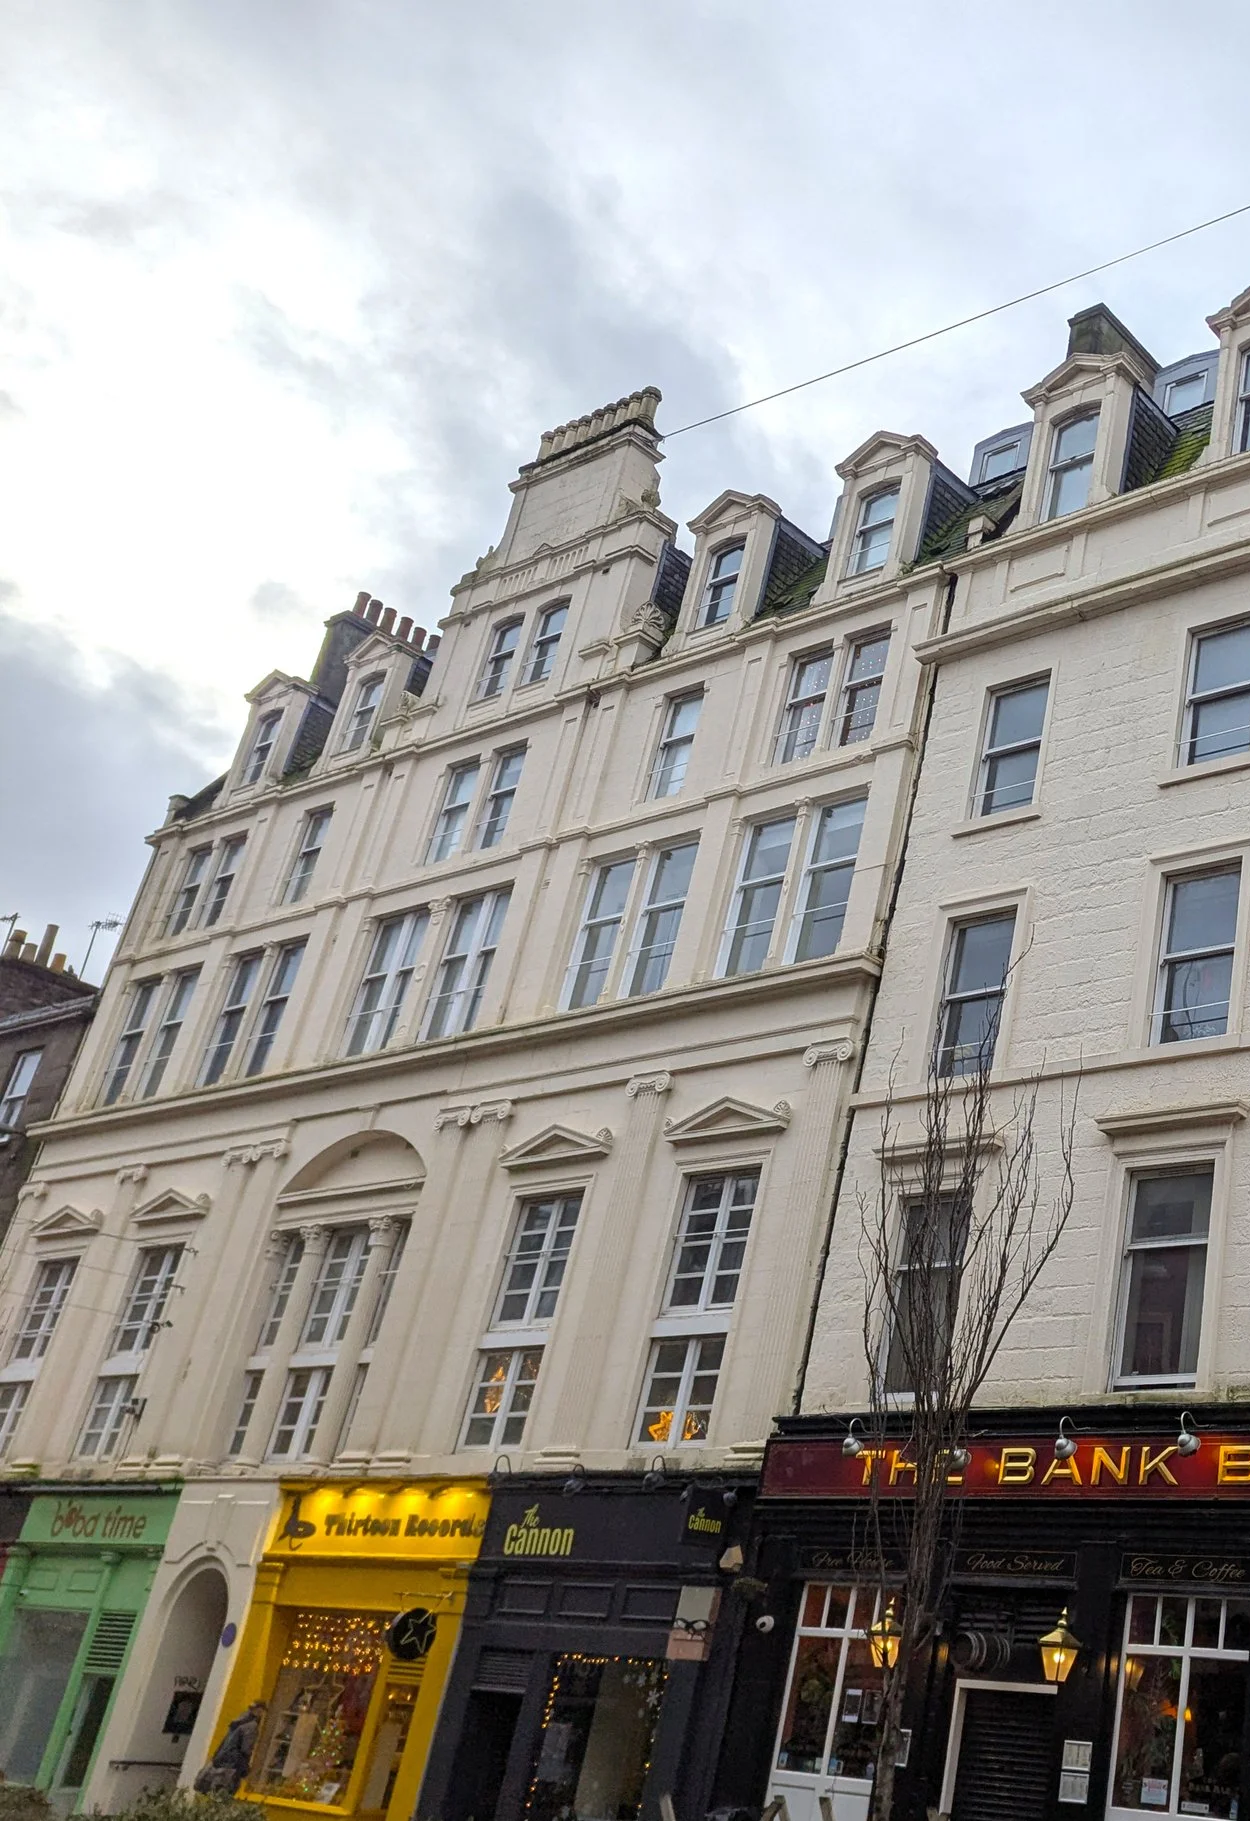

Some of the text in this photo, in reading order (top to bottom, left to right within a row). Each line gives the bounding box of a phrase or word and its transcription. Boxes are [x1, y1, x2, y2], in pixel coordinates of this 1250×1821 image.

[998, 1446, 1178, 1486] BANK
[102, 1505, 147, 1538] time
[325, 1512, 402, 1537] Thirteen
[521, 1503, 540, 1528] The
[688, 1514, 722, 1534] Cannon
[503, 1523, 575, 1556] Cannon
[967, 1553, 1064, 1572] Food Served
[1130, 1557, 1247, 1582] Tea & Coffee
